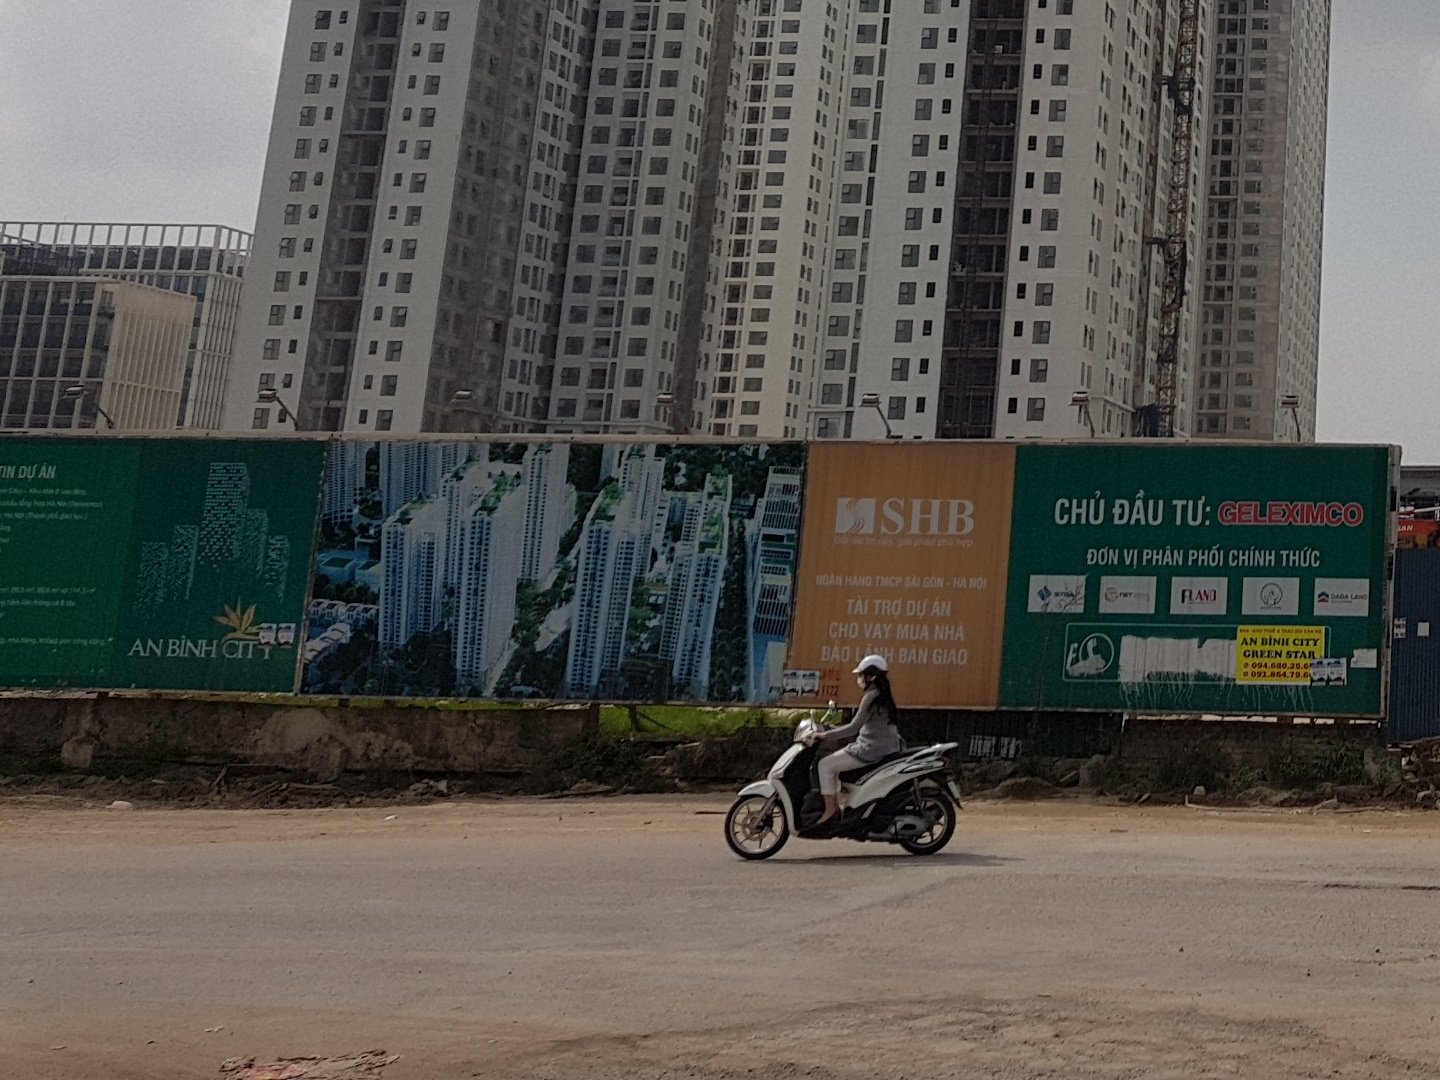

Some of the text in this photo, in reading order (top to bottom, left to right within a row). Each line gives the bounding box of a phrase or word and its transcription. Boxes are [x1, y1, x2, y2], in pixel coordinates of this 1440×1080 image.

[18, 463, 38, 481] DỰ
[38, 462, 57, 478] ÁN
[881, 498, 976, 535] SHB
[1054, 489, 1364, 527] CHỦ ĐẦU TƯ: GELEXIMCO
[1087, 544, 1320, 569] ĐƠN VỊ PHÂN PHỐI CHÍNH THỨC
[876, 576, 902, 587] TMCP
[847, 595, 952, 619] TÀI TRỢ DỰ ÁN
[829, 622, 858, 638] CHO
[864, 623, 892, 639] VAY
[896, 624, 929, 640] MUA
[1241, 635, 1320, 647] AN BÌNH CITY
[127, 638, 163, 657] AN
[166, 635, 218, 658] BÌNH
[822, 642, 851, 662] BẢO
[933, 649, 967, 665] GIAO
[1243, 650, 1316, 659] GREEN STAR
